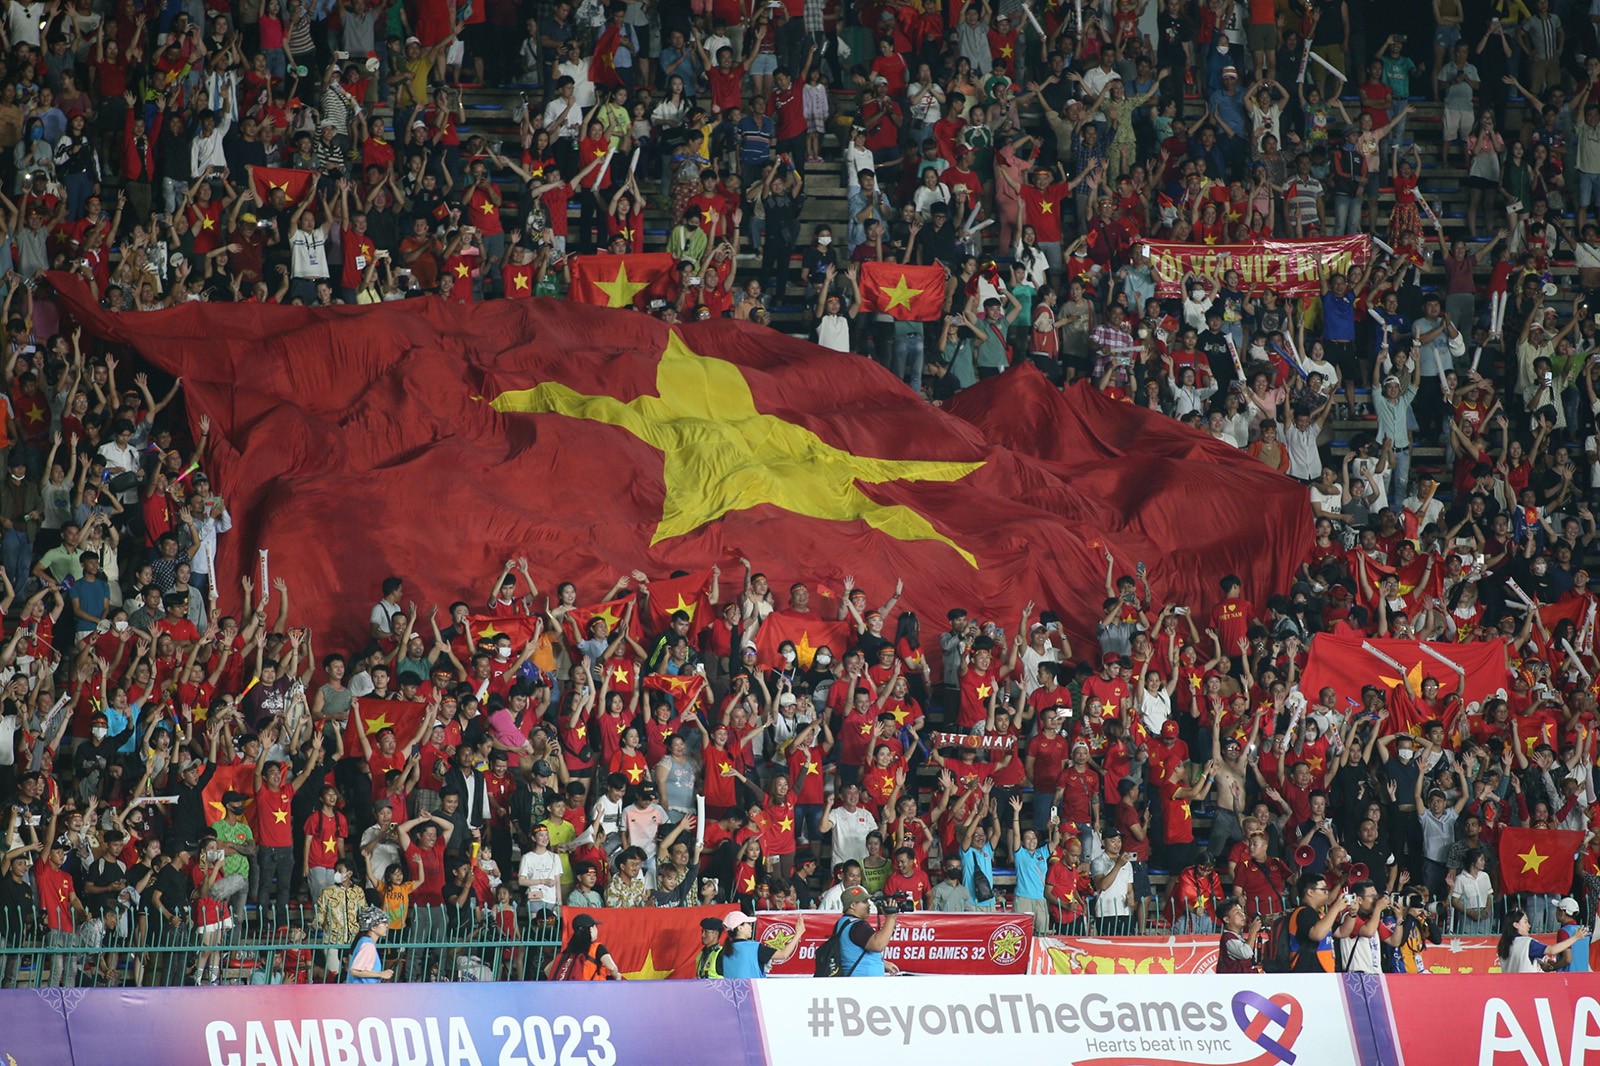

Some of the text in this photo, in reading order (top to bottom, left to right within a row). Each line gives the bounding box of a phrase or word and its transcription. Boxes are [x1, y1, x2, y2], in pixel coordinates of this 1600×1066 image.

[941, 733, 968, 745] IET
[889, 922, 935, 941] ỀN BẮC
[883, 947, 901, 960] NG
[903, 946, 926, 960] SEA
[929, 946, 968, 960] GAMES
[971, 946, 986, 960] 32
[808, 993, 1228, 1045] #BeyondTheGames
[205, 1015, 617, 1066] CAMBODIA 2023
[1086, 1036, 1232, 1054] Hearts beat in sync
